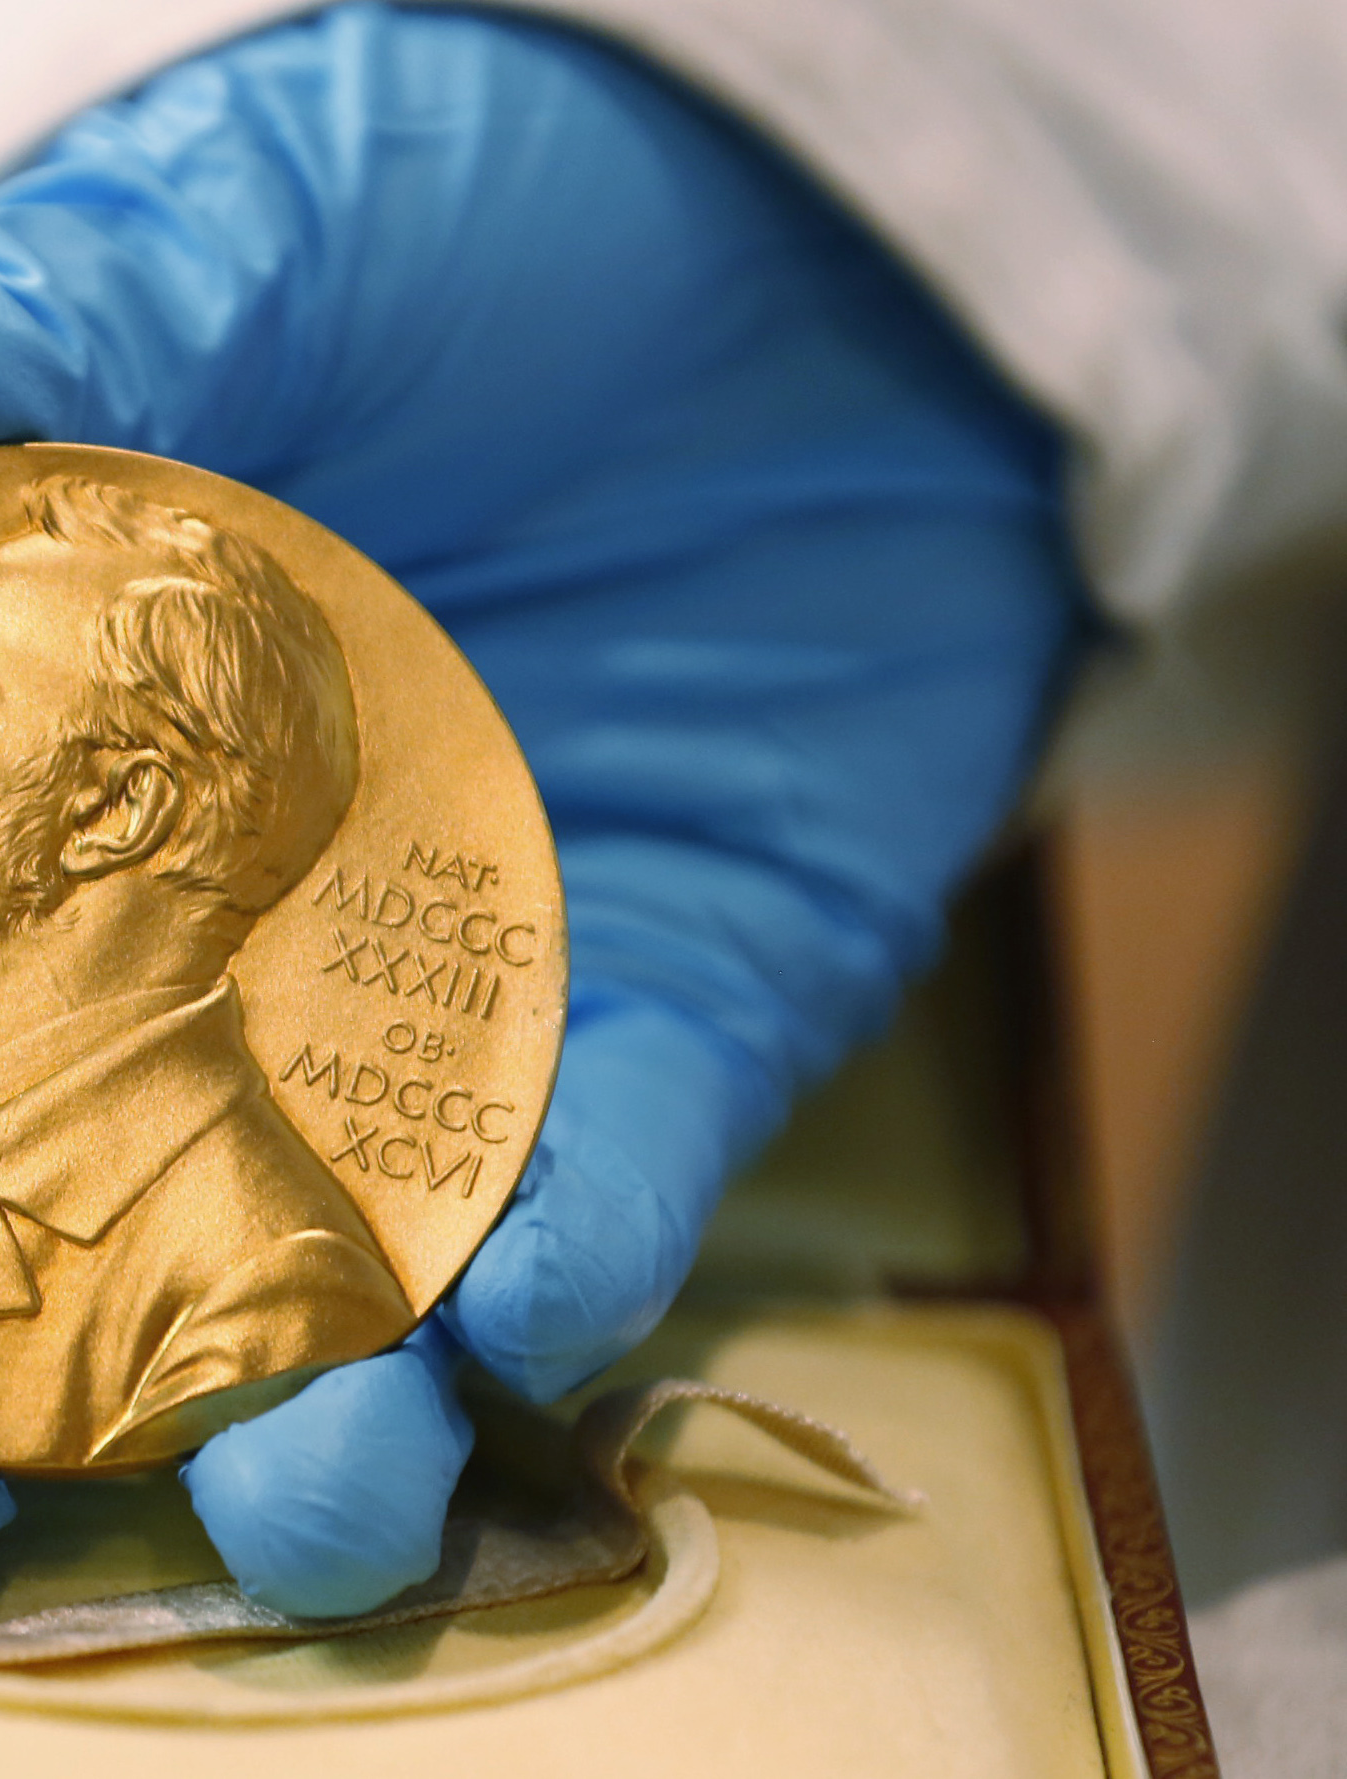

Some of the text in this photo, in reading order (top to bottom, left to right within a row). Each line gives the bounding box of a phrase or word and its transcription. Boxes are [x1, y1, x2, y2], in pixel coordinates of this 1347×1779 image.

[311, 866, 536, 967] MDCCC
[320, 924, 501, 1020] XXXIII
[279, 1042, 516, 1144] MDCCC
[330, 1115, 483, 1199] XCVI
